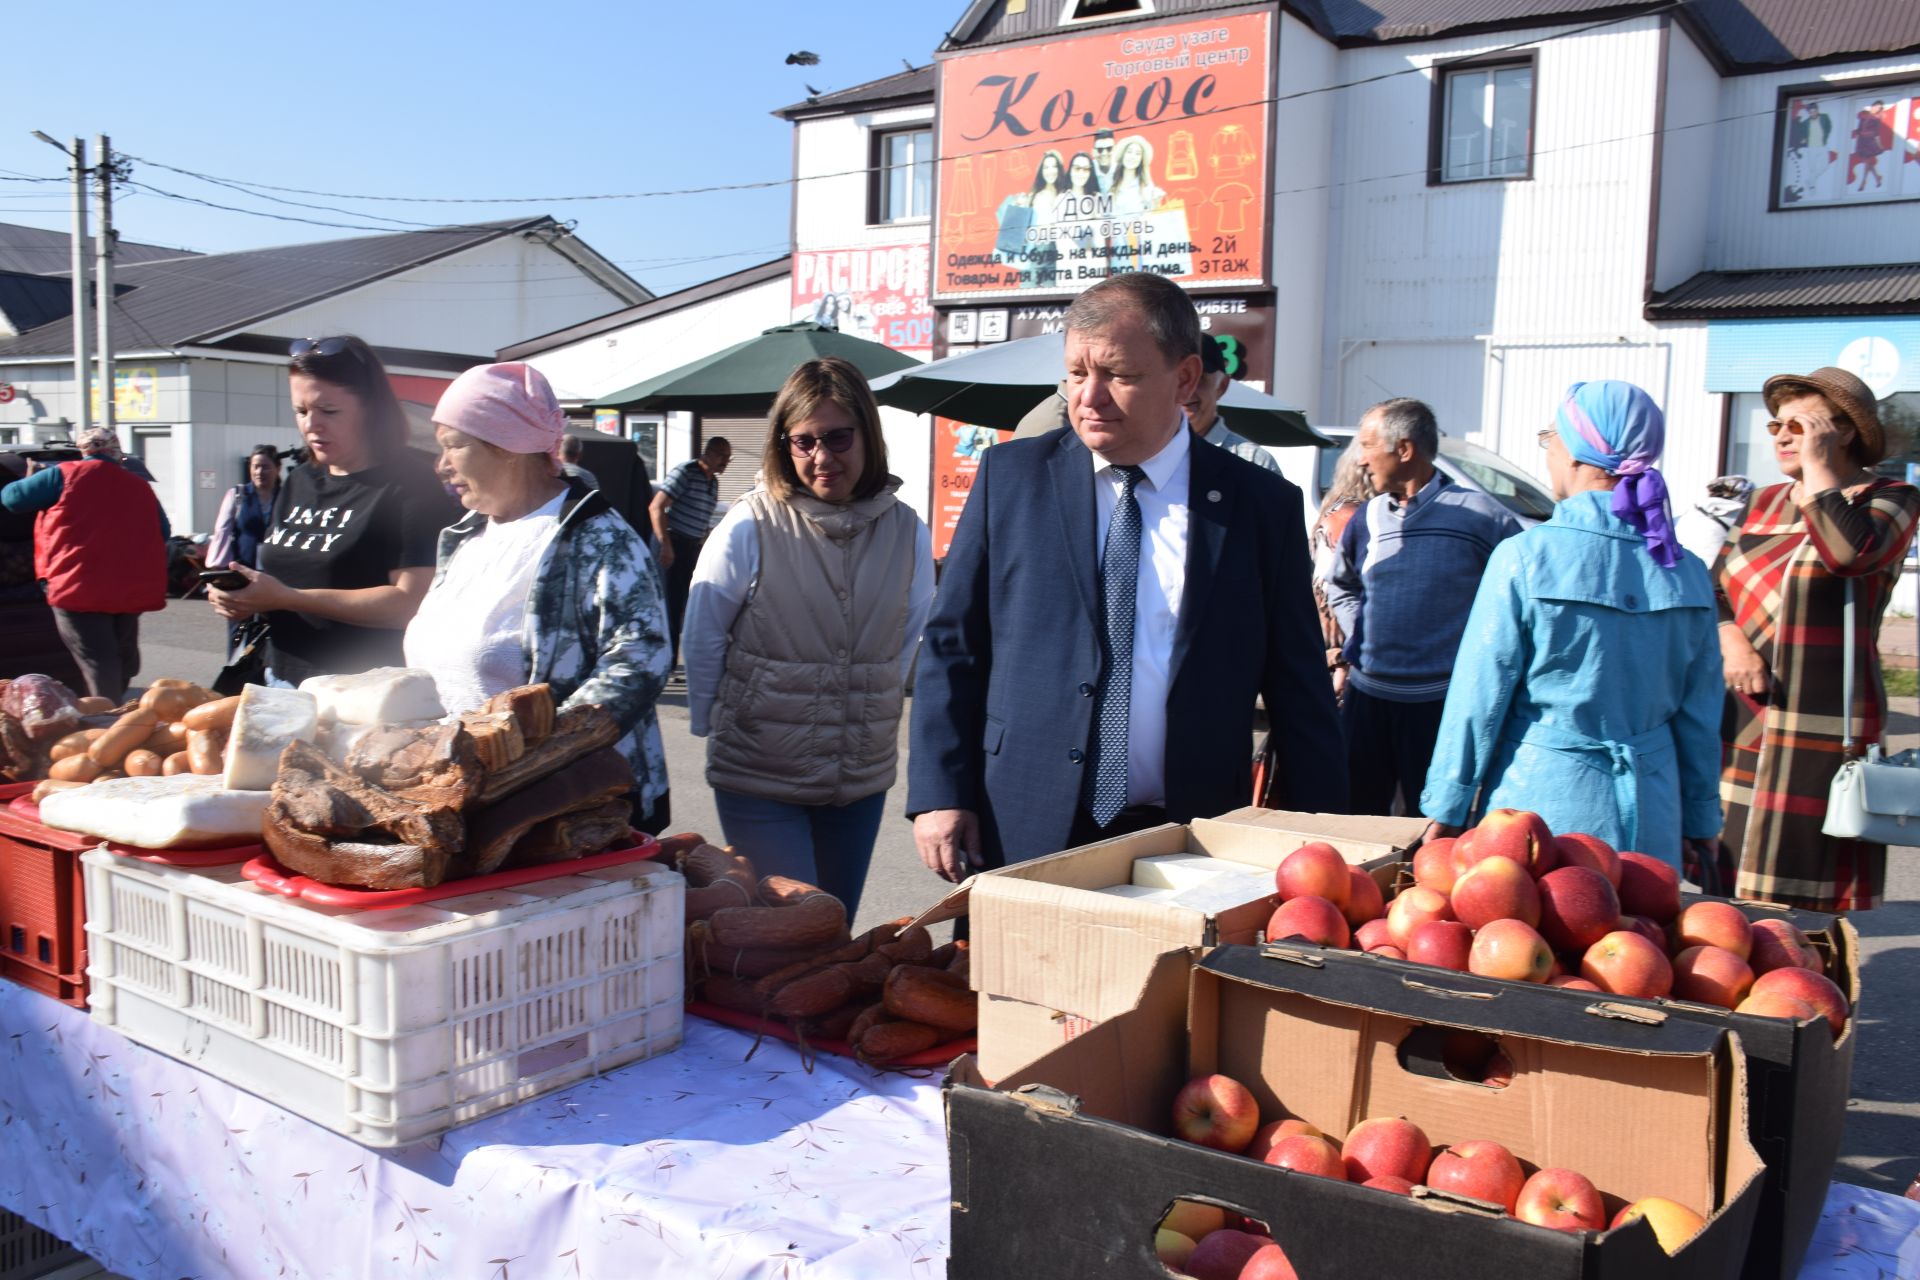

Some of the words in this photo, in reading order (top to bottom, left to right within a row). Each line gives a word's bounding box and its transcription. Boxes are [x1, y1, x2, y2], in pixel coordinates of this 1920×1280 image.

[1104, 51, 1191, 79] Торговый
[1196, 47, 1250, 66] центр
[961, 72, 1217, 141] Колос
[1064, 195, 1113, 218] ДОМ
[1026, 225, 1093, 242] ОДЕЖДА
[1100, 221, 1155, 237] ОБУВЬ
[947, 254, 1001, 269] Одежда
[1007, 252, 1015, 263] и
[1069, 247, 1086, 259] на
[1092, 239, 1152, 260] каждый
[1212, 235, 1237, 254] 2й
[1200, 257, 1249, 273] этаж
[947, 272, 999, 288] Товары
[1004, 271, 1032, 286] для
[283, 506, 355, 529] INFI
